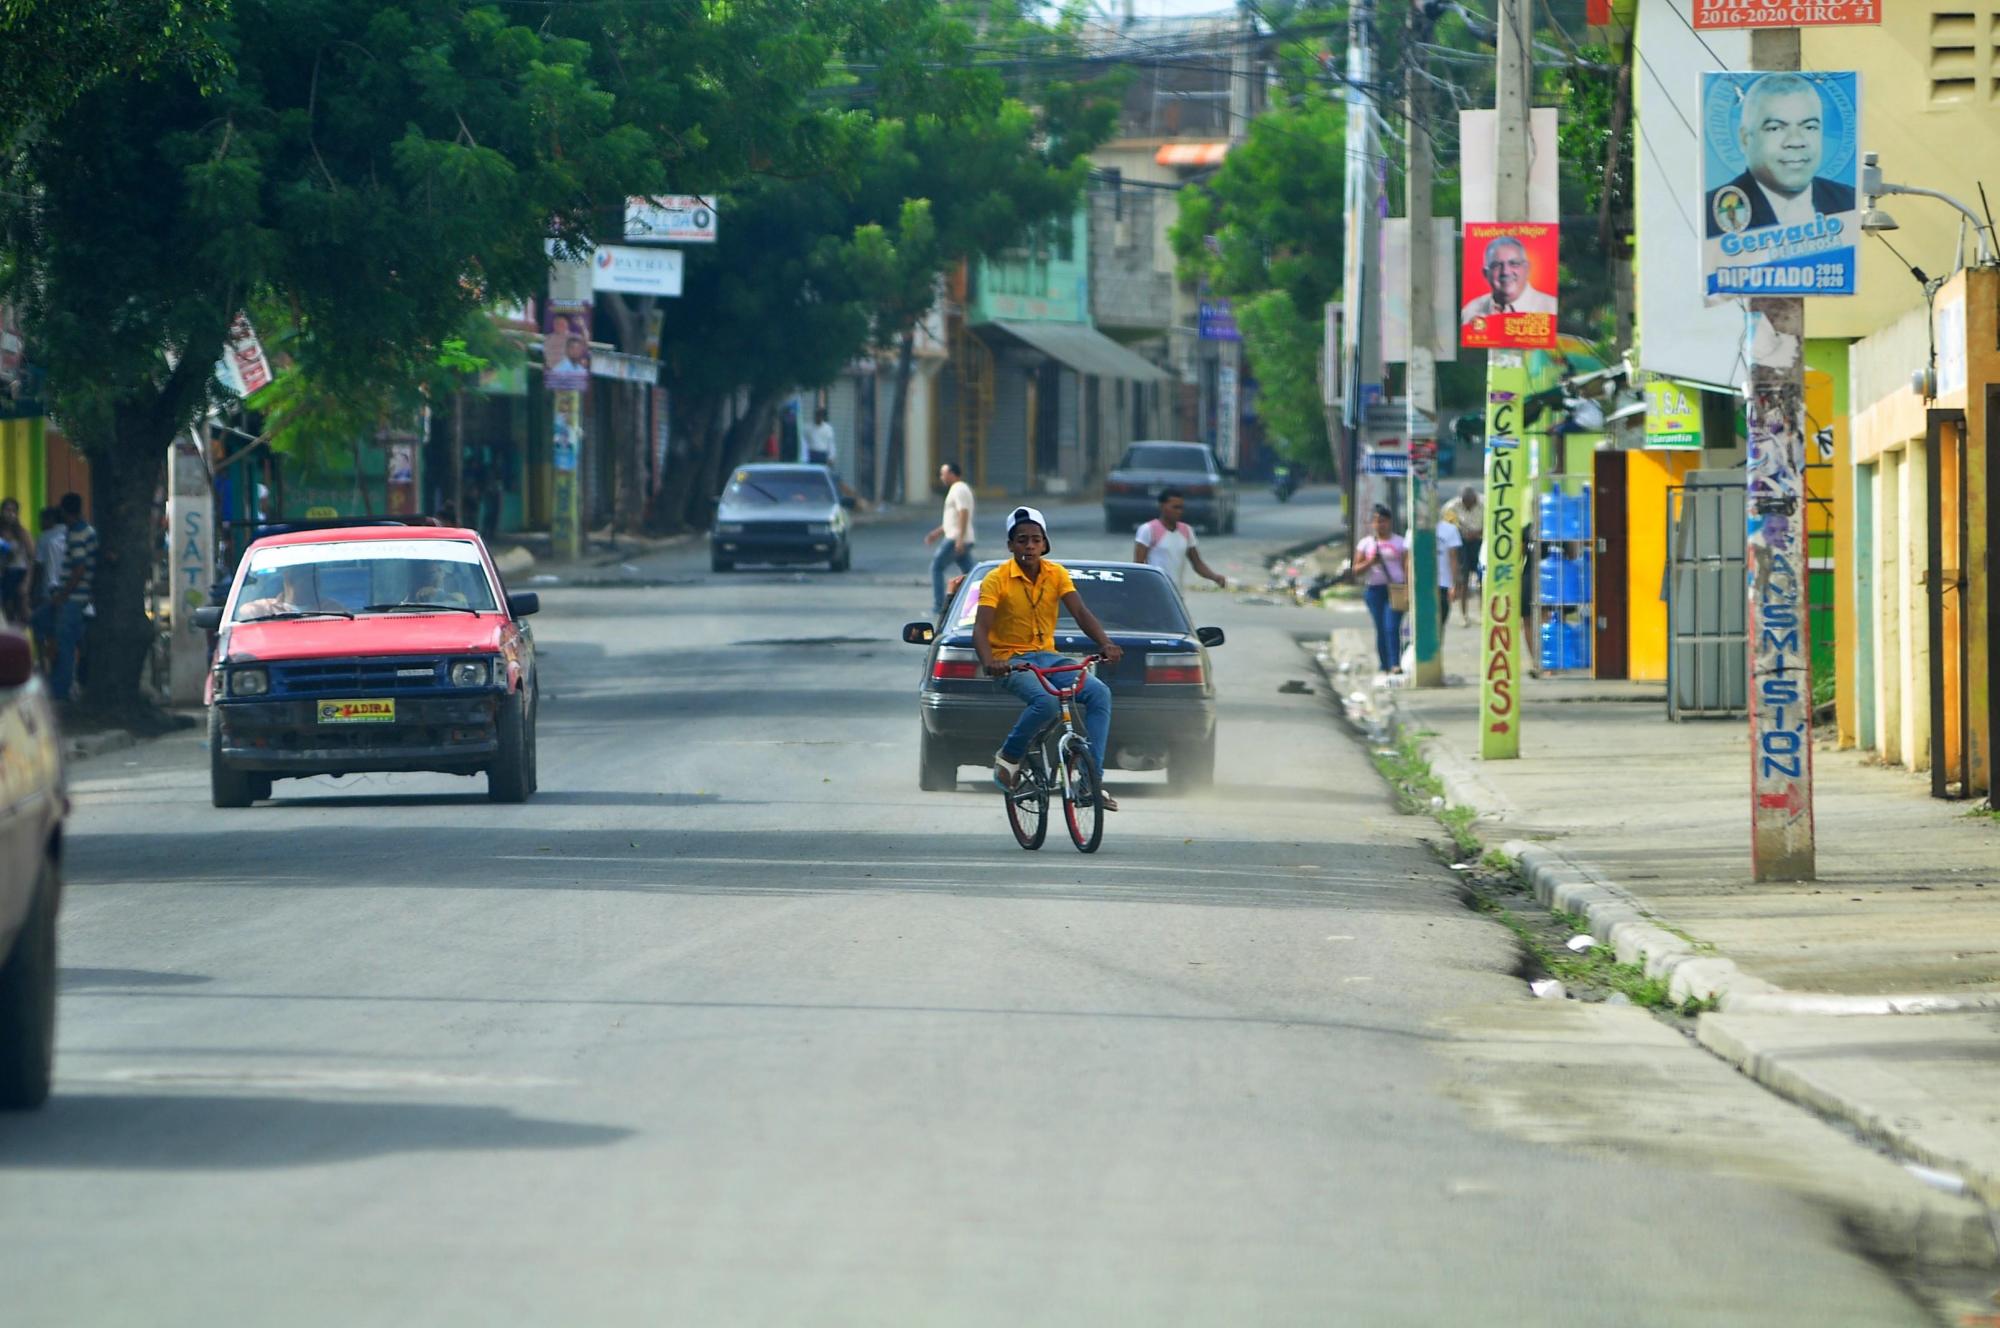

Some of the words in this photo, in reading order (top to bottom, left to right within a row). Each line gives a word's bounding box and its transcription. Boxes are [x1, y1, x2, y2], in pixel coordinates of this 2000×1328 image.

[1700, 8, 1788, 24] 2016-2020
[1790, 5, 1847, 21] CIRC.
[1853, 5, 1874, 19] #1
[1719, 211, 1843, 257] Gervacio
[615, 257, 674, 271] PATRIA
[1816, 263, 1844, 276] 2016
[1716, 265, 1815, 288] DIPUTADO
[1816, 275, 1844, 288] 2020
[1503, 326, 1550, 337] SUED
[1663, 390, 1692, 415] S.A.
[1487, 594, 1512, 716] UNAS
